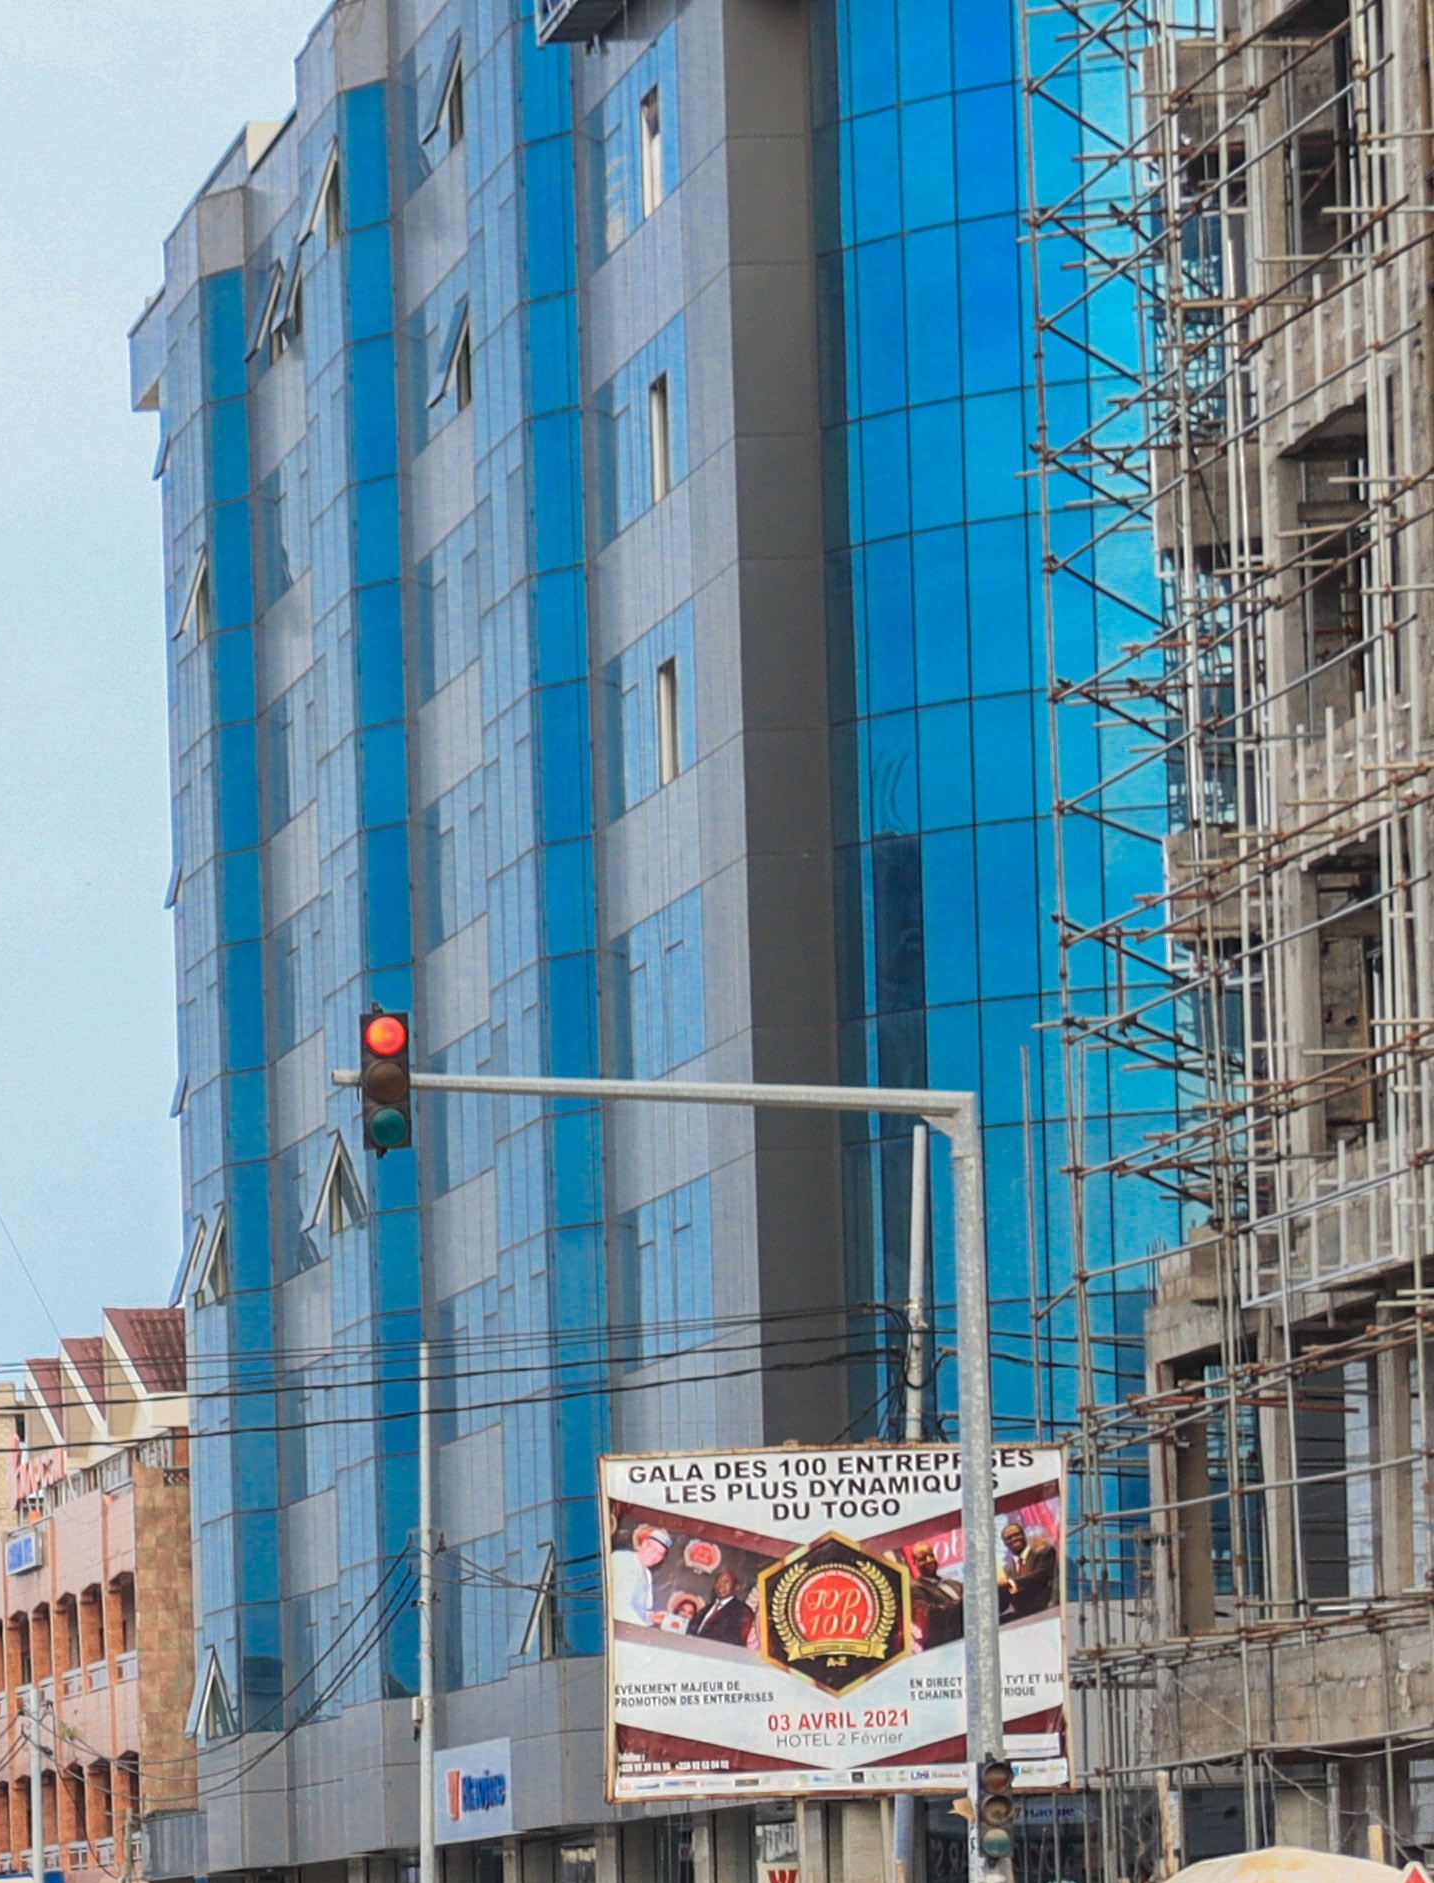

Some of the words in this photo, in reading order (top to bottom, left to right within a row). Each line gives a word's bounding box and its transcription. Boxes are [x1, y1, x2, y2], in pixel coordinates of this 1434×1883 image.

[628, 1463, 705, 1484] GALA
[714, 1459, 768, 1480] DES
[780, 1457, 827, 1477] 100
[665, 1482, 716, 1505] LES
[727, 1479, 798, 1501] PLUS
[808, 1474, 1000, 1499] DYNAMIQUS
[772, 1502, 812, 1522] DU
[821, 1498, 901, 1519] TOGO
[807, 1614, 858, 1636] 100
[680, 1681, 724, 1694] MAJEUR
[726, 1680, 740, 1691] DE
[909, 1678, 923, 1689] EN
[926, 1677, 963, 1688] DIRECT
[1005, 1675, 1024, 1685] TVT
[1027, 1674, 1041, 1684] ET
[615, 1695, 677, 1708] PROMOTION
[680, 1693, 699, 1705] DES
[703, 1691, 774, 1705] ENTREPRISES
[918, 1689, 964, 1700] CHAINES
[767, 1713, 791, 1732] 03
[798, 1711, 857, 1730] AVRIL
[864, 1708, 910, 1728] 2021
[776, 1734, 832, 1749] HOTEL
[837, 1733, 846, 1747] 2
[851, 1730, 904, 1745] Février
